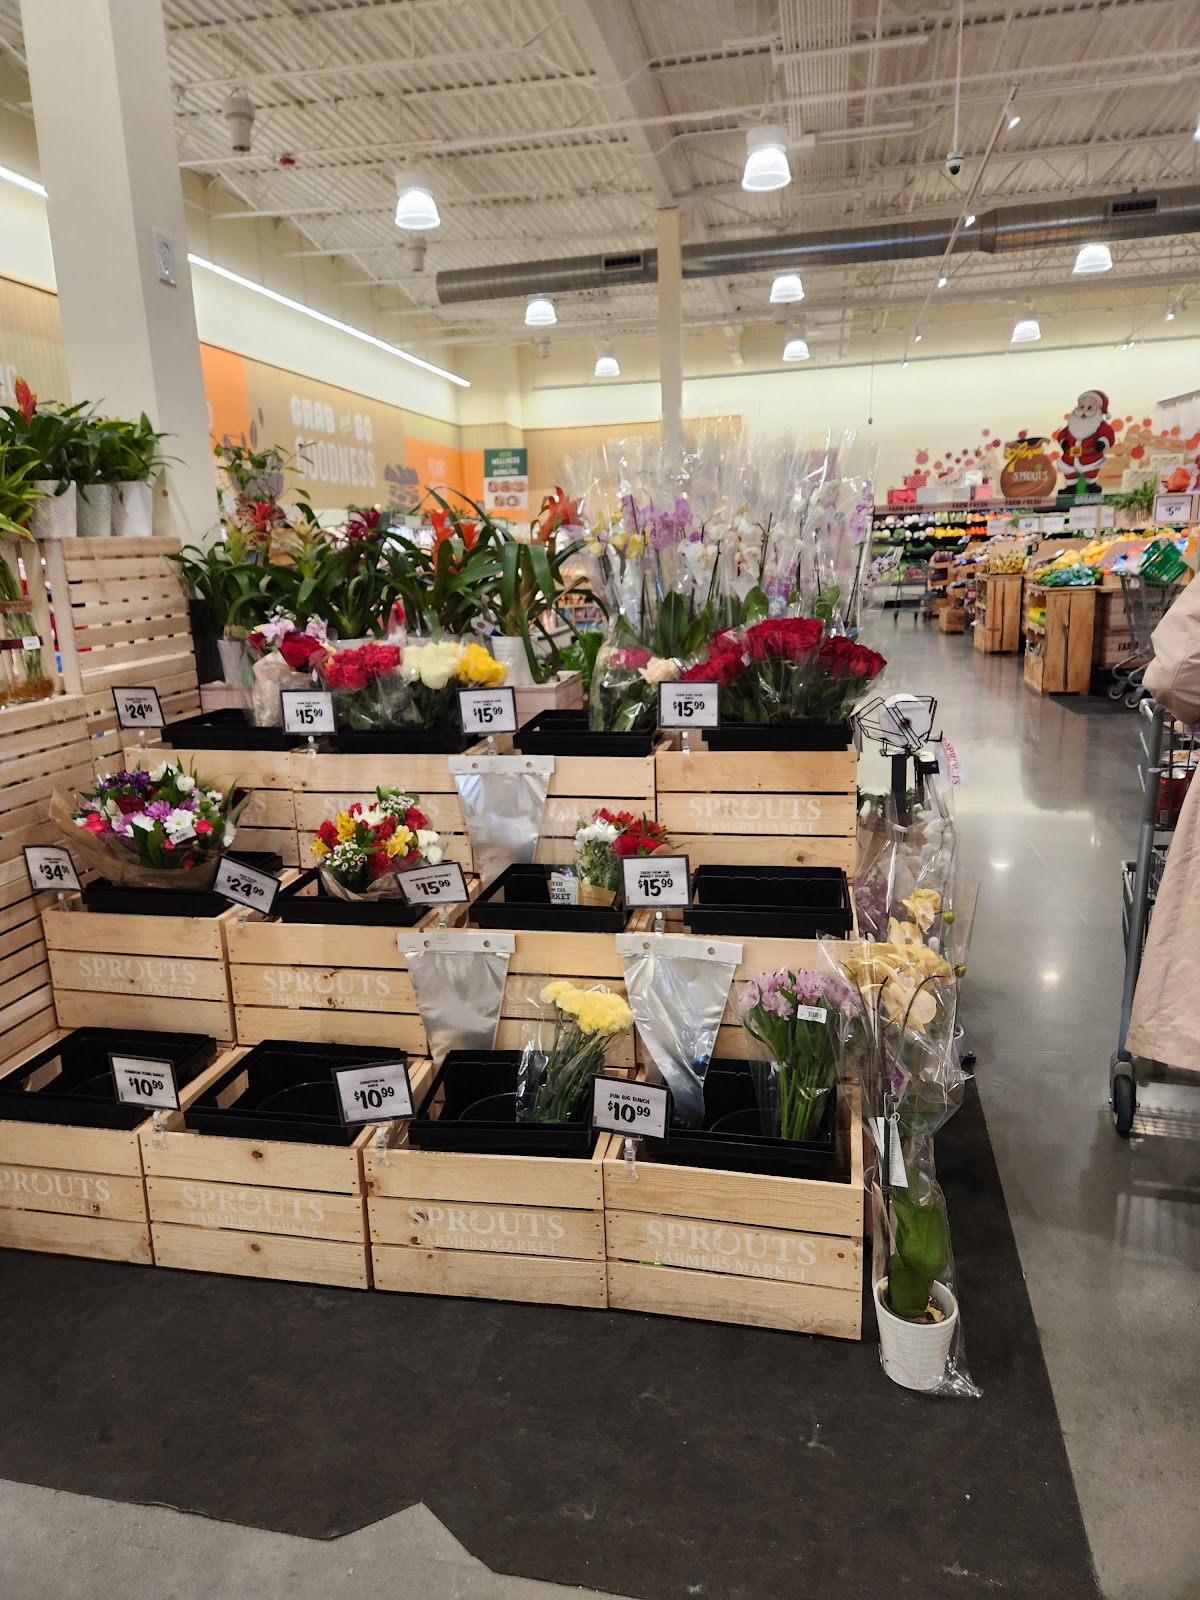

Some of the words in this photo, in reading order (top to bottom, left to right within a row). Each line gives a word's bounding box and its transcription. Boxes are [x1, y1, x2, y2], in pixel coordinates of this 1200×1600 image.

[290, 394, 335, 434] GRAB
[354, 412, 374, 445] GO
[294, 435, 377, 489] GOODNESS
[1013, 470, 1049, 481] SPROUTS
[688, 796, 821, 820] SPROUTS
[79, 956, 197, 984] SPROUTS
[263, 969, 391, 997] SPROUTS
[632, 1096, 650, 1104] BUNCH
[0, 1167, 111, 1201] PROUTS
[181, 1183, 326, 1222] SPROUTS
[190, 1211, 255, 1228] FARMERS
[258, 1217, 320, 1236] MARKET
[407, 1205, 566, 1240] SPROUTS
[417, 1232, 488, 1250] FARMERS
[491, 1239, 559, 1254] MARKET
[647, 1220, 818, 1266] SPROUTS
[655, 1250, 731, 1270] FARMERS
[735, 1260, 809, 1281] MARKET
